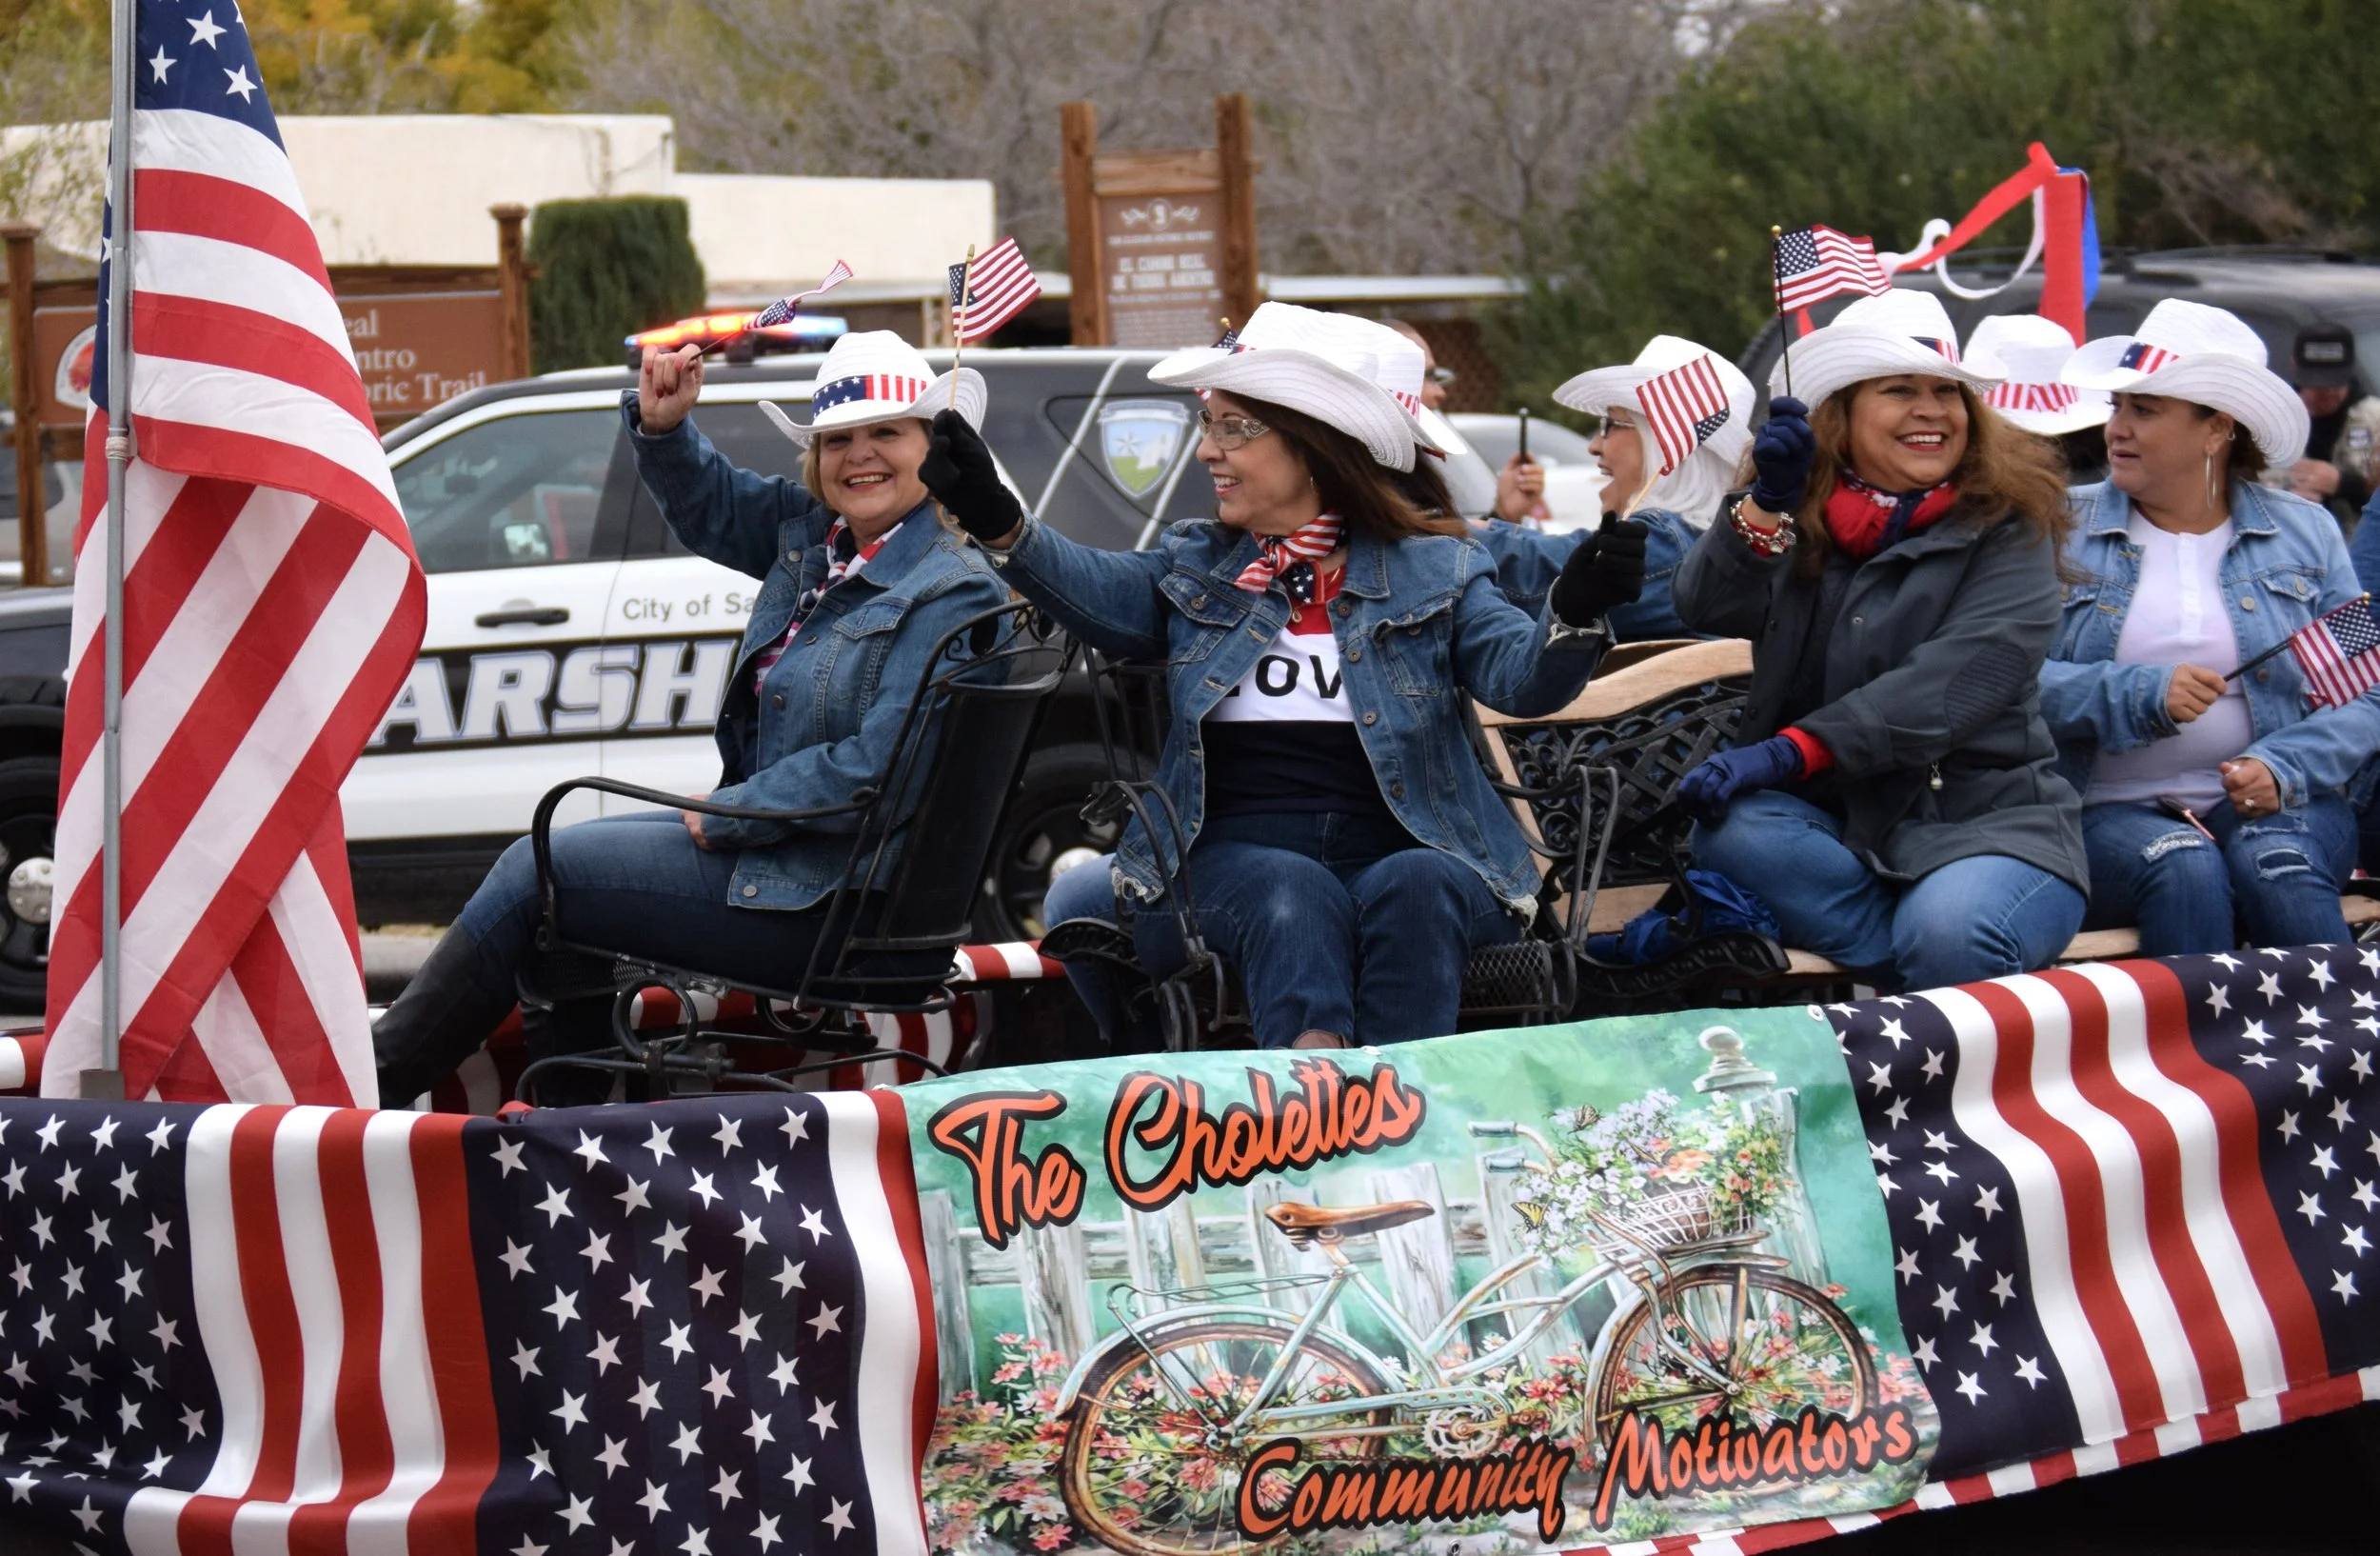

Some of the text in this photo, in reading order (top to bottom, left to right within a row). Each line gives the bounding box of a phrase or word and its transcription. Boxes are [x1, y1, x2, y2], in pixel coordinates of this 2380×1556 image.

[344, 309, 378, 336] eal
[356, 349, 416, 369] ntro
[623, 591, 755, 622] City of Sa
[366, 638, 739, 747] ARSH
[1225, 654, 1342, 699] OV
[928, 1057, 1427, 1250] The Cholettes
[1237, 1404, 1920, 1544] Community Motivators
